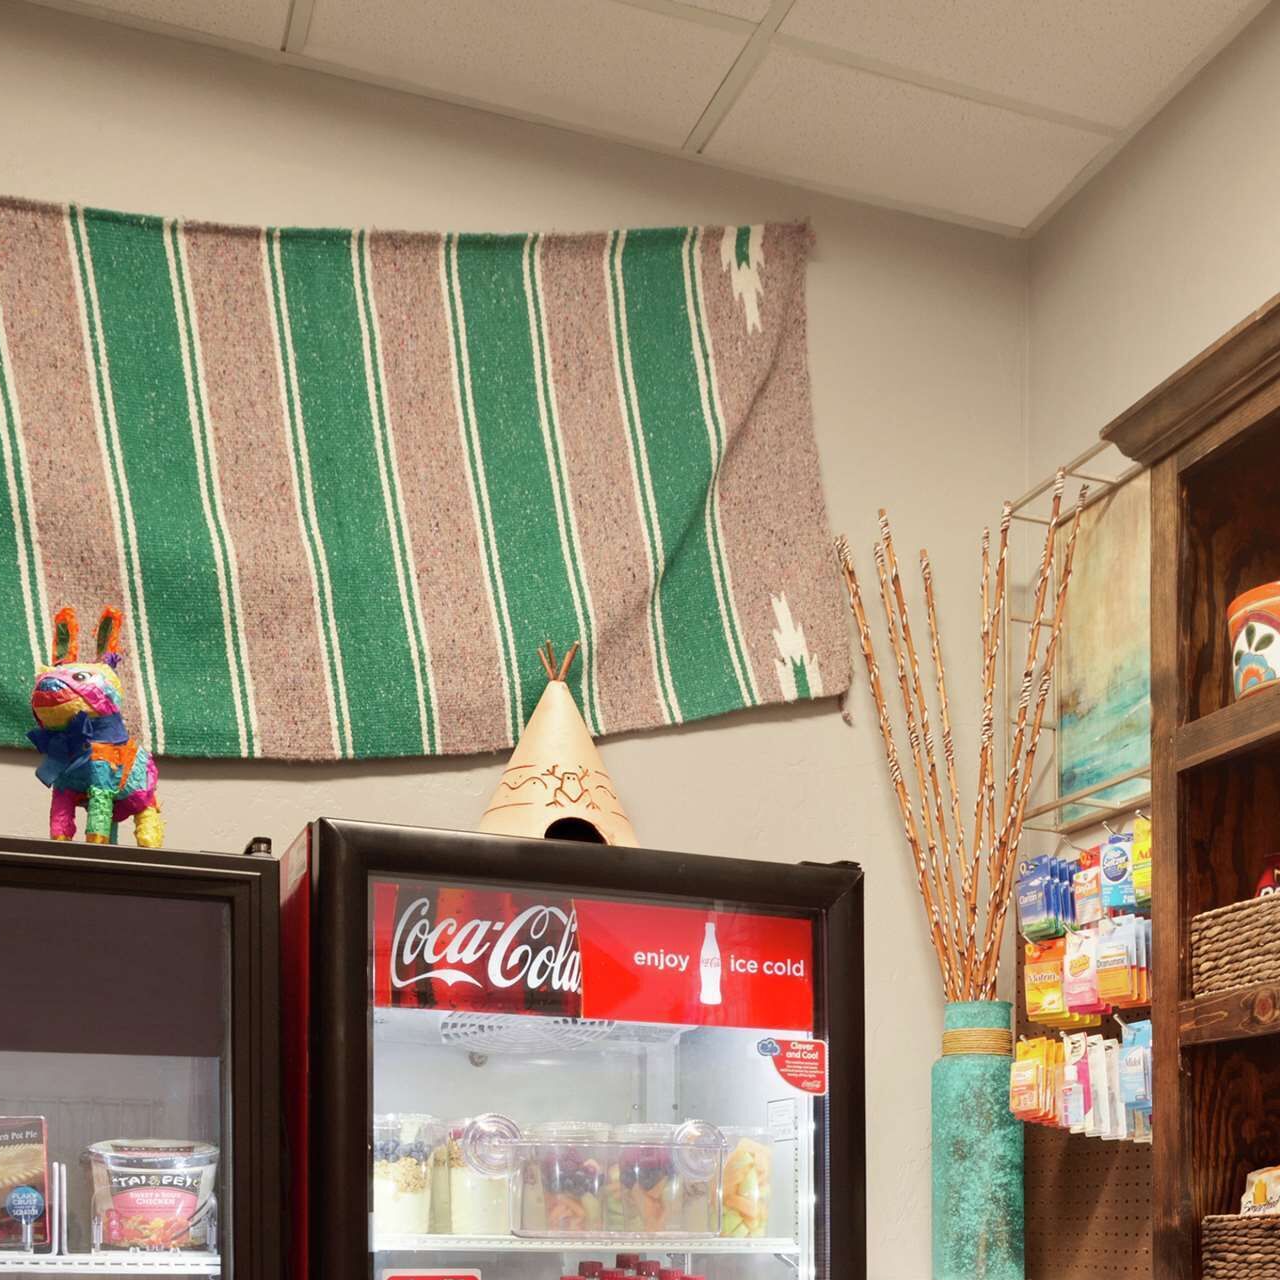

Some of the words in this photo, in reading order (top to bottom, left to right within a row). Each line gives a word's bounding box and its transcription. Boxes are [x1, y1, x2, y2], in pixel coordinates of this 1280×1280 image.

[391, 897, 582, 994] Coca-Cola
[633, 949, 691, 972] enjoy
[730, 954, 758, 974] ice
[762, 959, 805, 977] cold
[11, 1132, 25, 1143] Pot
[118, 1175, 147, 1187] TAI
[162, 1174, 192, 1188] PEI
[135, 1198, 176, 1206] CHICKEN
